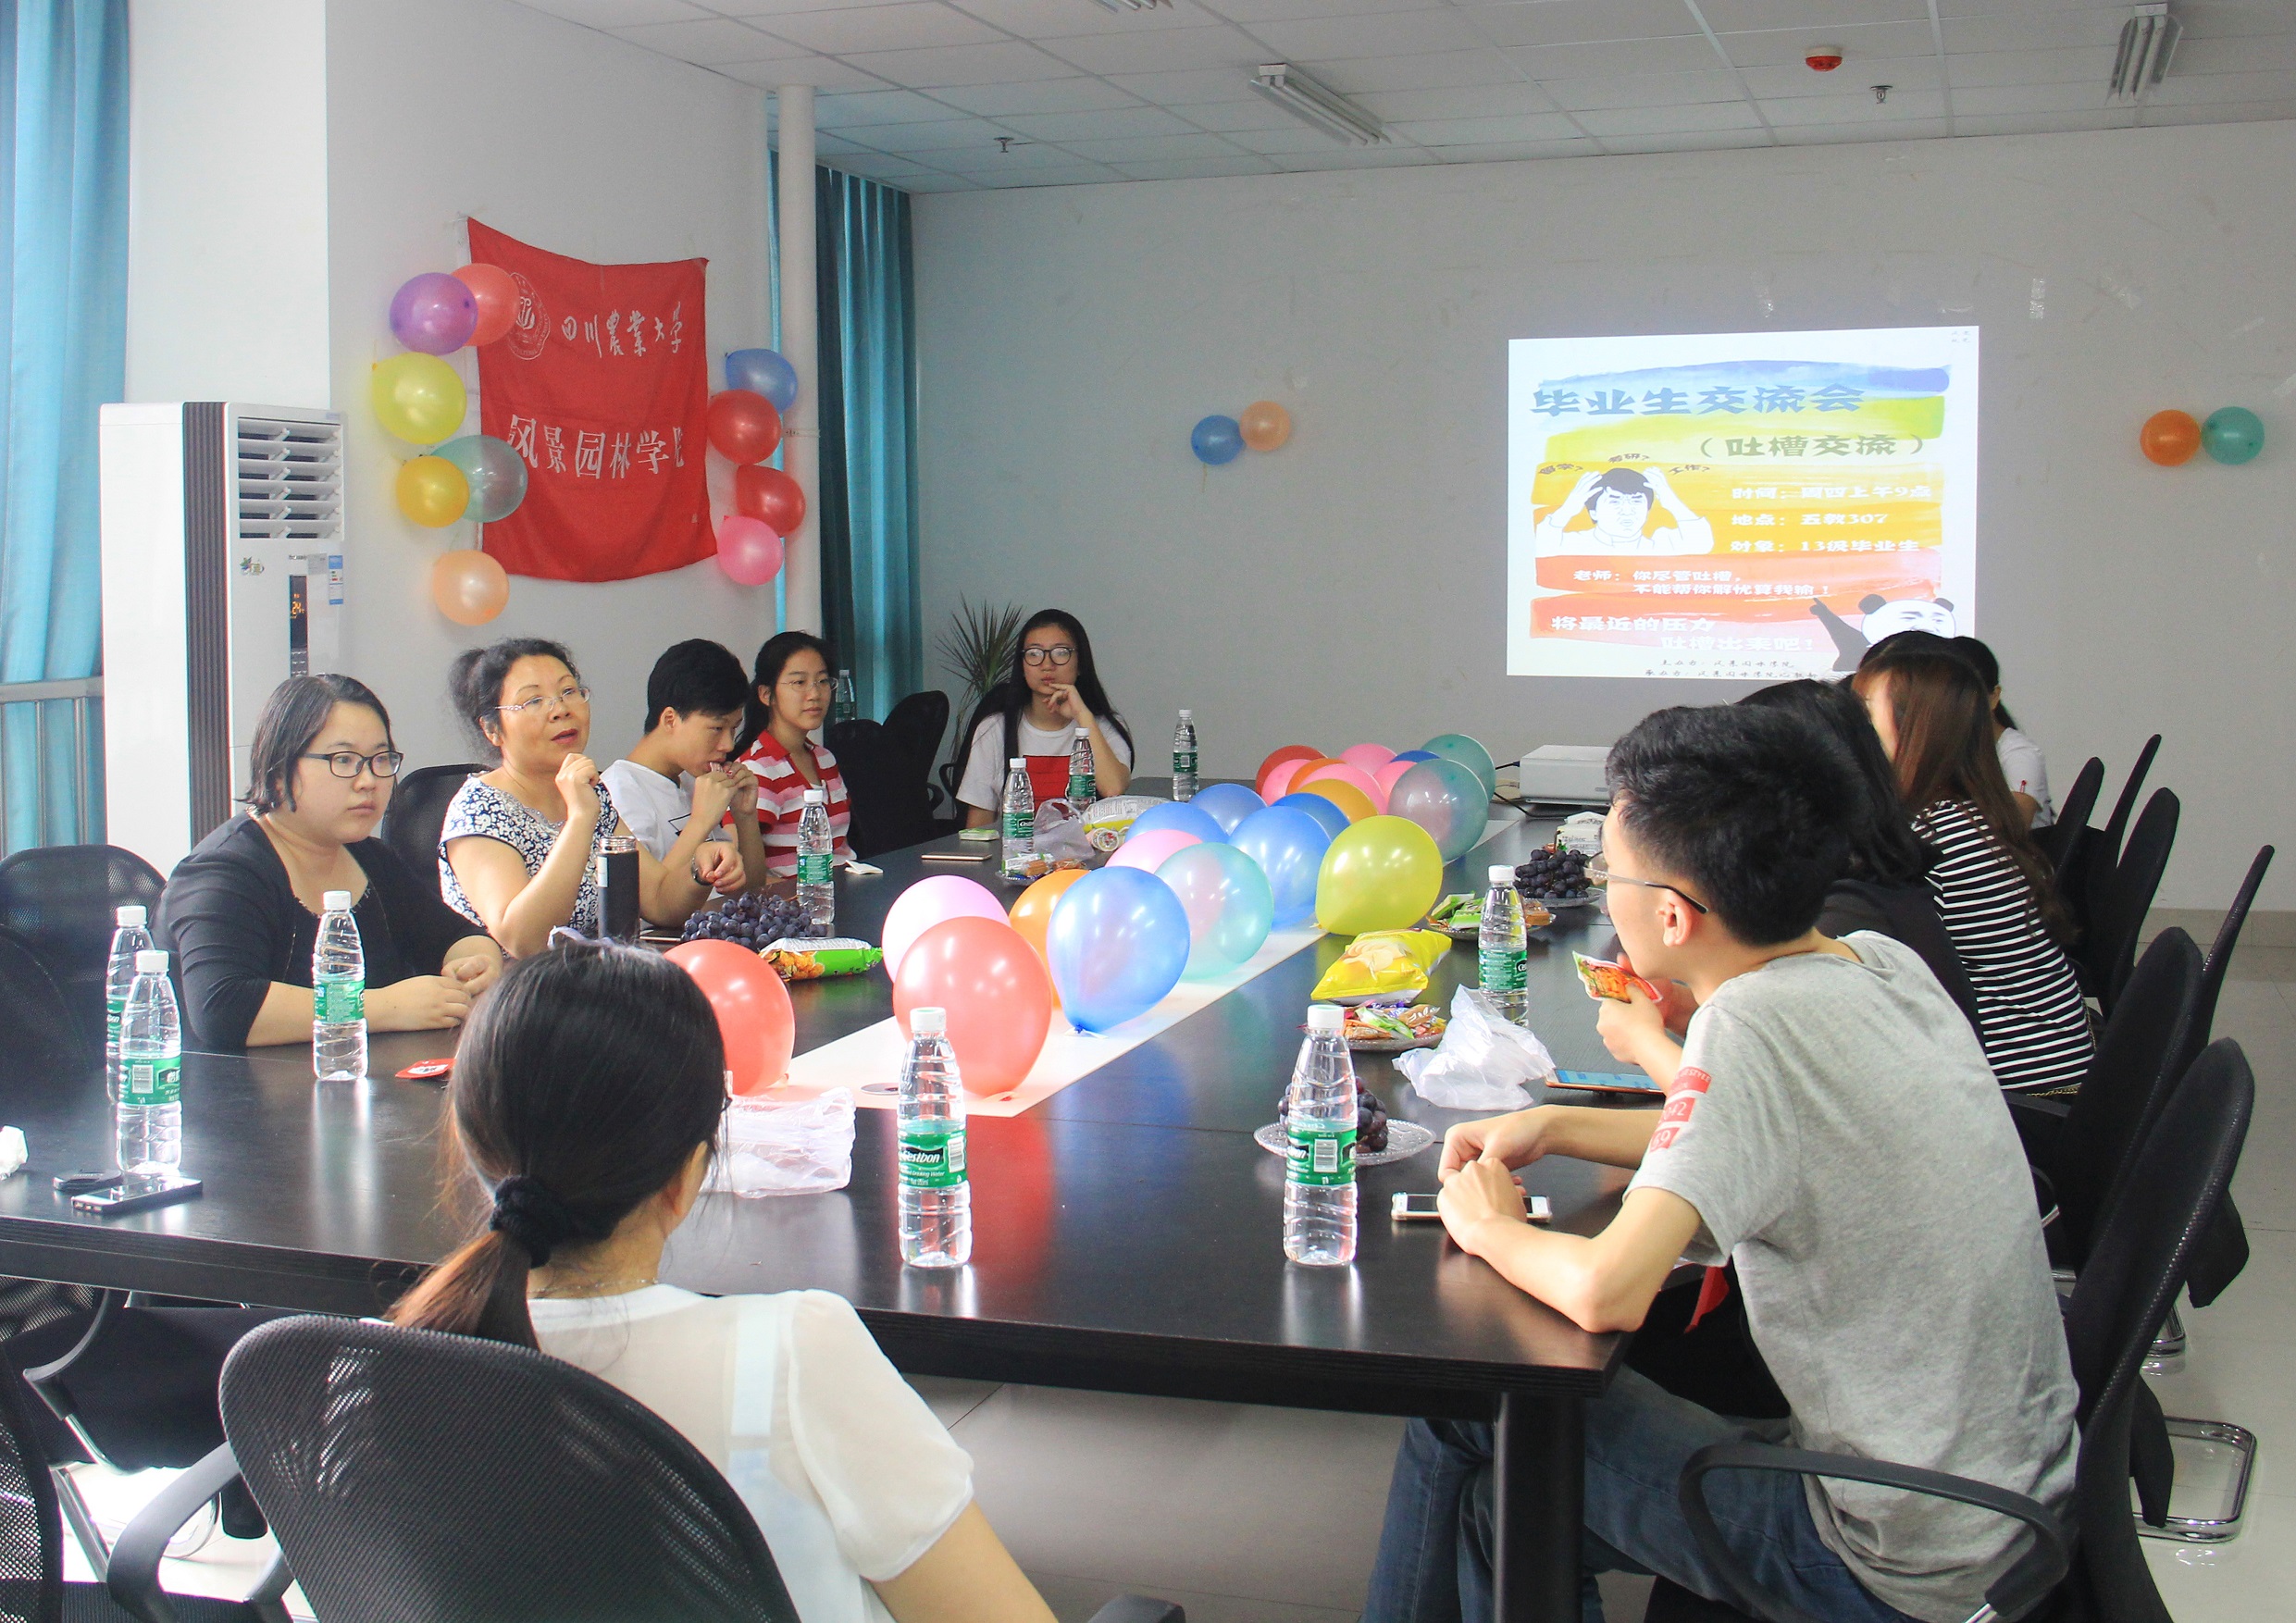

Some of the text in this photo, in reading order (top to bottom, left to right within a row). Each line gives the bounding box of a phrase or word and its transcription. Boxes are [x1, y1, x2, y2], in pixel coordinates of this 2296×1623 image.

[1530, 382, 1865, 417] 毕业生交流会
[1551, 615, 1718, 632] 将最近的压力
